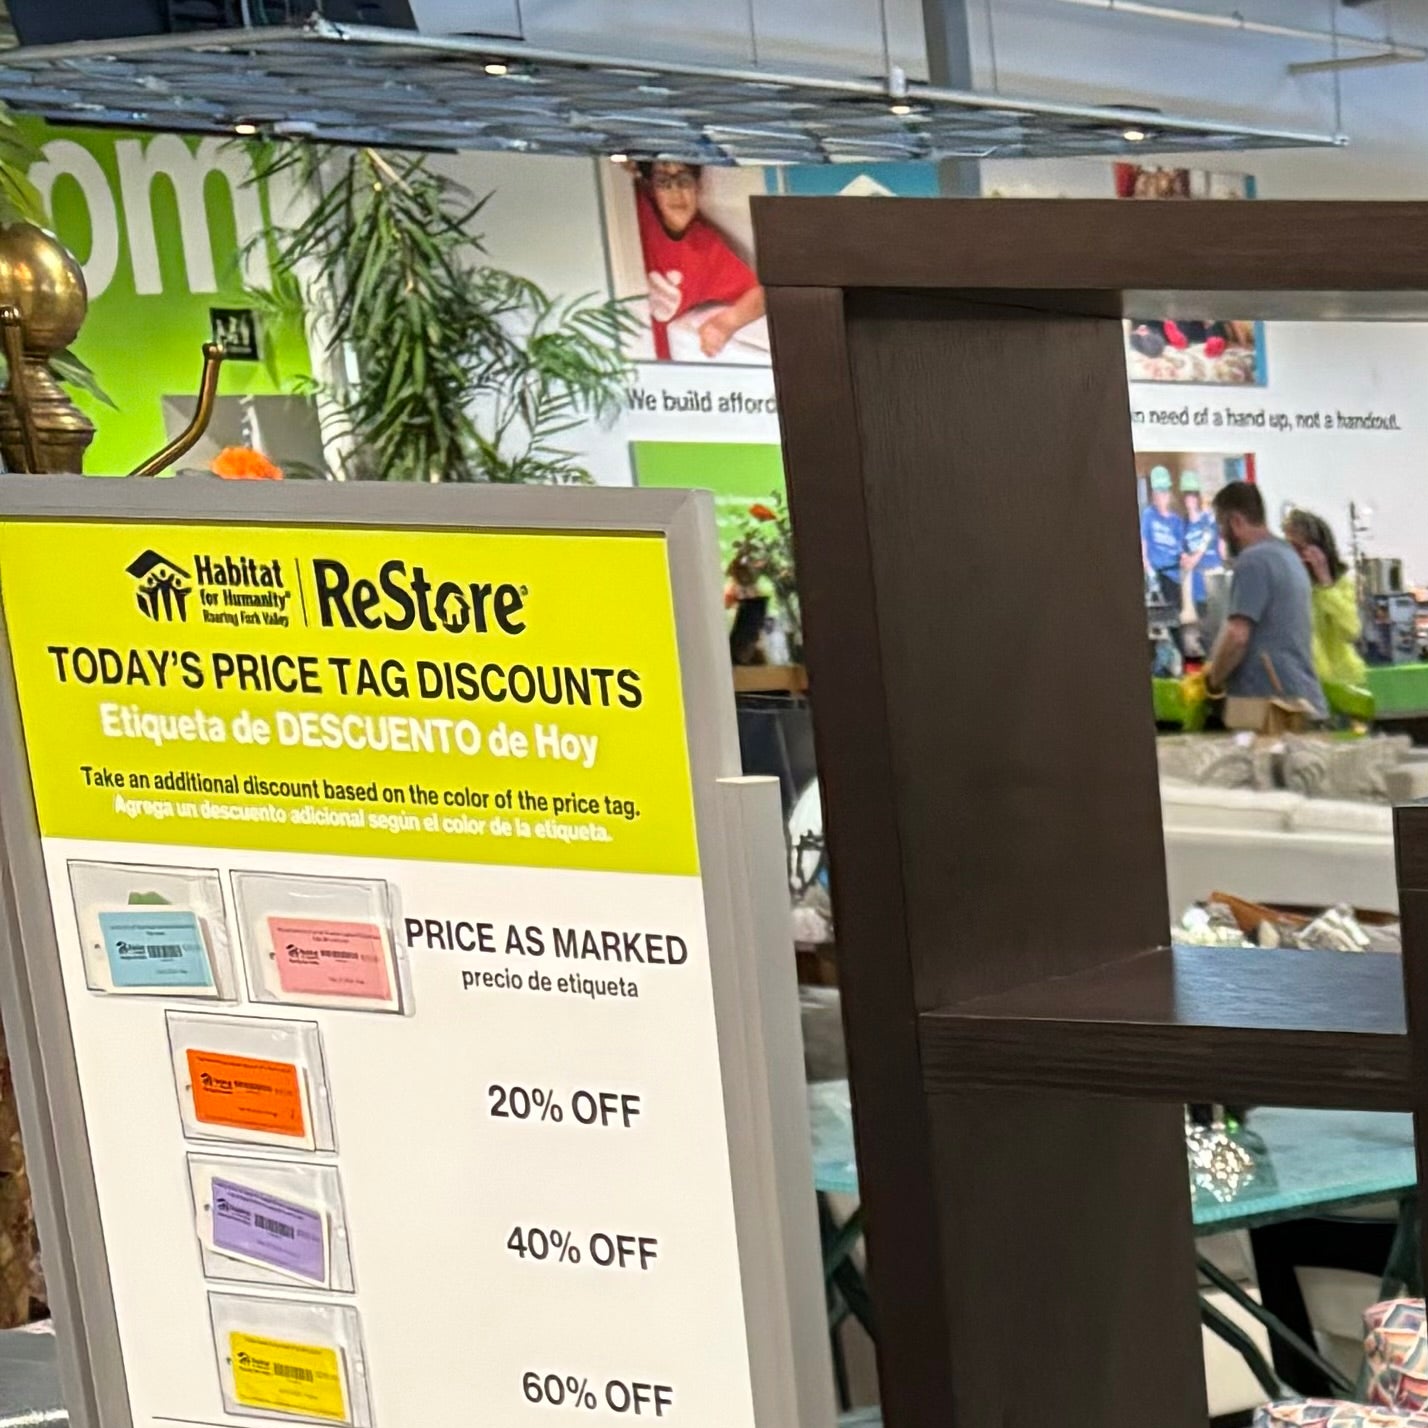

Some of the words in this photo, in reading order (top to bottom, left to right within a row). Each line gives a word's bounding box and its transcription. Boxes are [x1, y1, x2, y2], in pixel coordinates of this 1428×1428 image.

[626, 388, 657, 411] We
[662, 389, 713, 412] build
[1149, 406, 1190, 426] need
[1193, 407, 1209, 426] of
[1212, 411, 1224, 427] a
[1226, 408, 1266, 428] hand
[1269, 414, 1293, 431] up,
[1295, 411, 1321, 430] not
[193, 554, 284, 588] Habitat
[199, 588, 219, 607] for
[312, 558, 527, 636] ReStore
[47, 645, 205, 689] TODAY'S
[212, 652, 322, 694] PRICE
[328, 657, 410, 699] TAG
[416, 660, 643, 709] DISCOUNTS
[99, 701, 226, 748] Etiqueta
[232, 710, 271, 746] de
[274, 710, 482, 757] DESCUENTO
[488, 720, 529, 759] de
[534, 722, 599, 769] Hoy
[80, 766, 125, 788] Take
[129, 773, 150, 790] an
[154, 771, 239, 795] additional
[243, 775, 319, 800] discount
[324, 780, 377, 802] based
[382, 786, 405, 804] on
[409, 783, 439, 806] the
[443, 787, 490, 809] color
[494, 789, 513, 810] of
[518, 790, 548, 812] the
[553, 792, 600, 816] price
[604, 795, 641, 820] tag.
[113, 794, 174, 821] Agrega
[175, 799, 199, 818] un
[200, 798, 287, 824] descuento
[290, 804, 365, 829] adicional
[423, 813, 440, 833] el
[442, 812, 485, 836] color
[489, 816, 512, 838] de
[515, 817, 531, 839] la
[404, 917, 497, 954] PRICE
[504, 923, 546, 957] AS
[552, 927, 689, 966] MARKED
[461, 967, 523, 991] precio
[528, 970, 552, 992] de
[556, 973, 639, 1000] etiqueta
[486, 1083, 564, 1124] 20%
[570, 1090, 642, 1129] OFF
[506, 1225, 582, 1266] 40%
[588, 1231, 659, 1272] OFF
[521, 1371, 598, 1412] 60%
[605, 1378, 675, 1419] OFF
